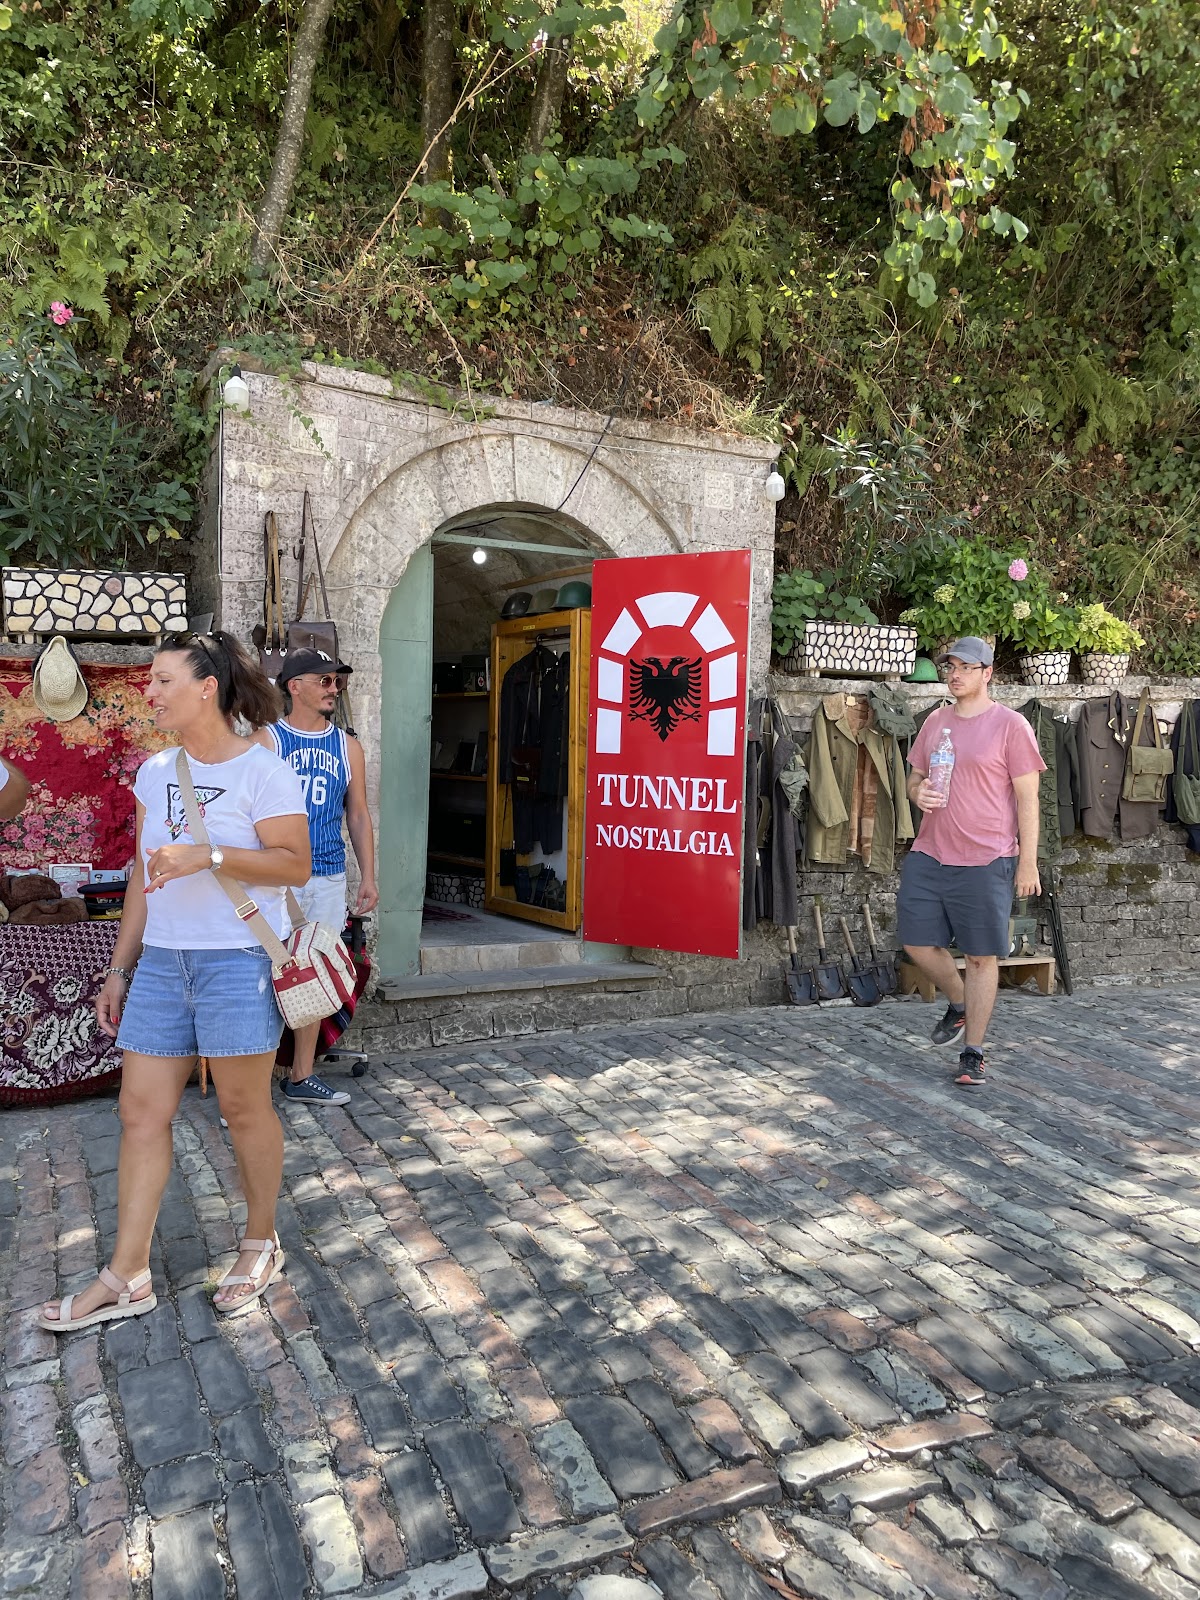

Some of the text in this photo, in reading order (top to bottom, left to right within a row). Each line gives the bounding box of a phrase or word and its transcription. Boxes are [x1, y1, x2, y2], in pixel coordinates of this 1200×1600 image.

[297, 774, 328, 806] 76
[597, 773, 737, 814] TUNNEL
[595, 823, 735, 857] NOSTALGIA
